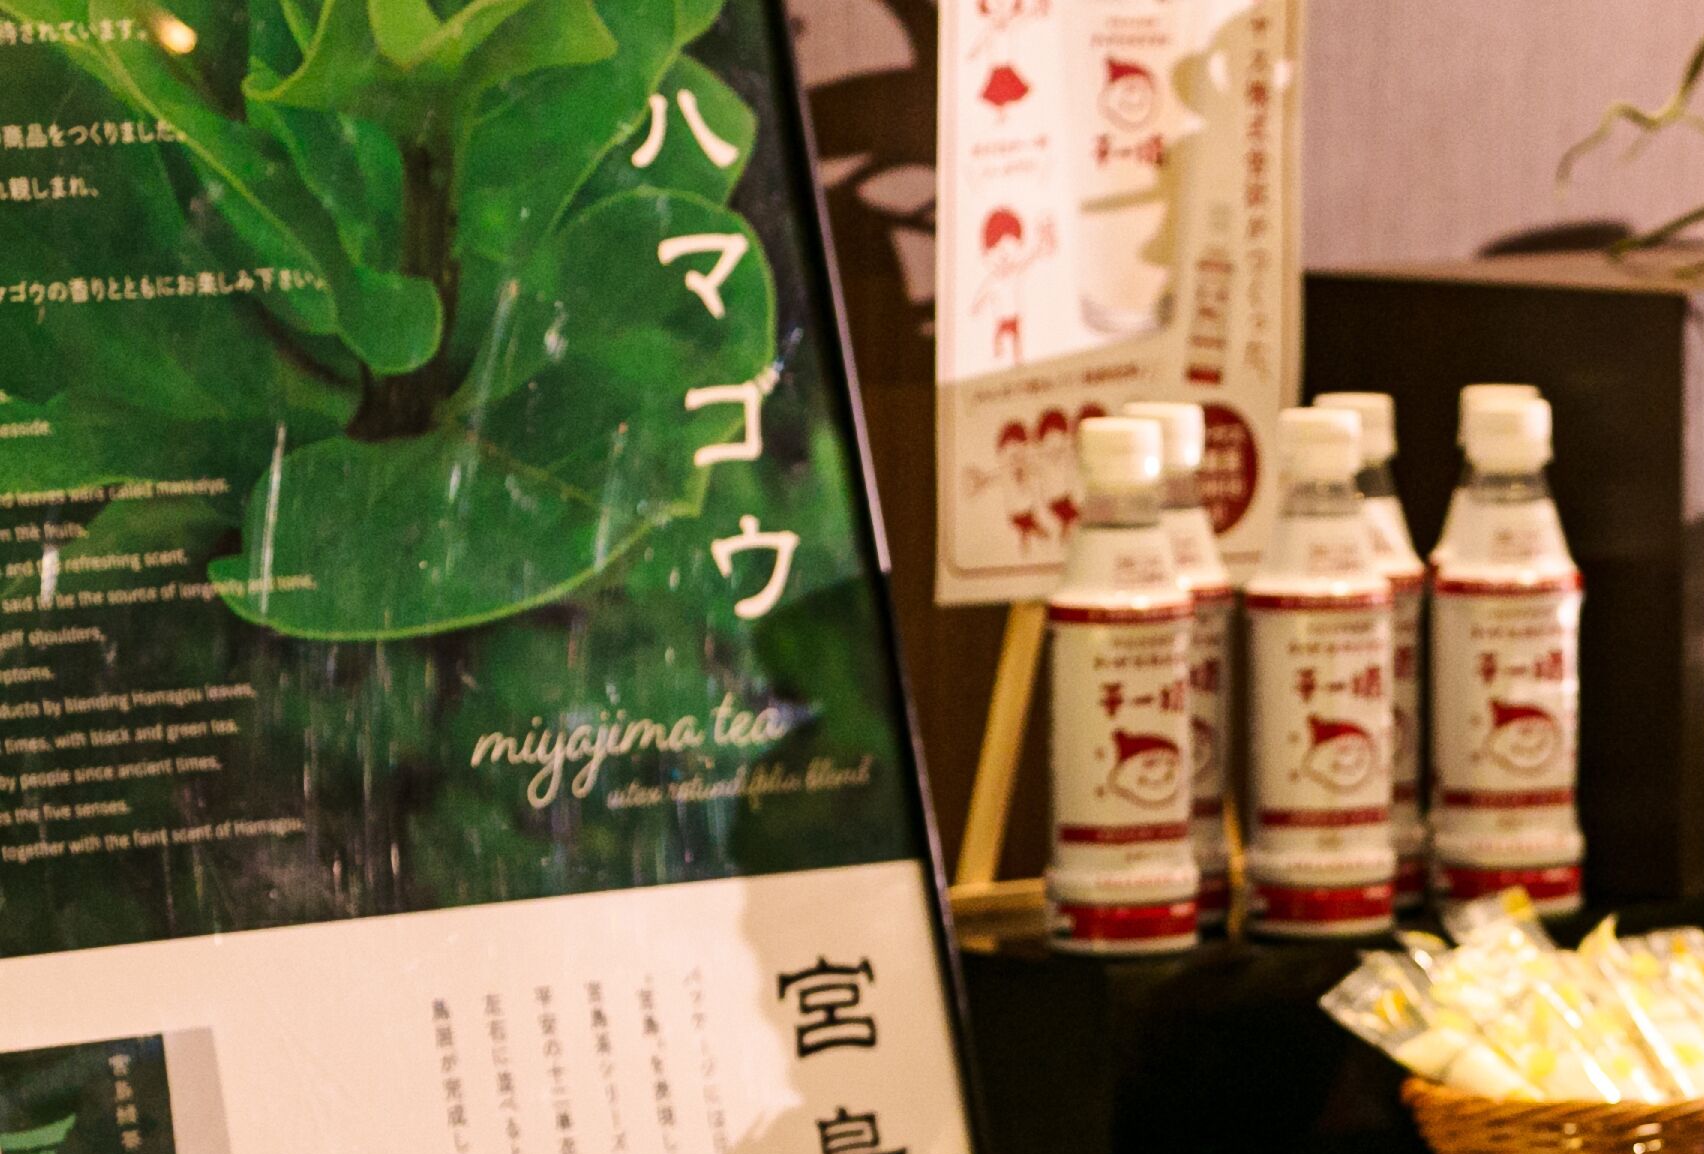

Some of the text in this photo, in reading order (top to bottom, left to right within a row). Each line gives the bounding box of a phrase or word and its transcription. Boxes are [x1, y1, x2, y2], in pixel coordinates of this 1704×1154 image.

[0, 267, 325, 304] ゴウの香りとともにお楽しみ下さい。
[632, 90, 799, 618] ハマゴウ
[471, 691, 788, 809] miyajima tea
